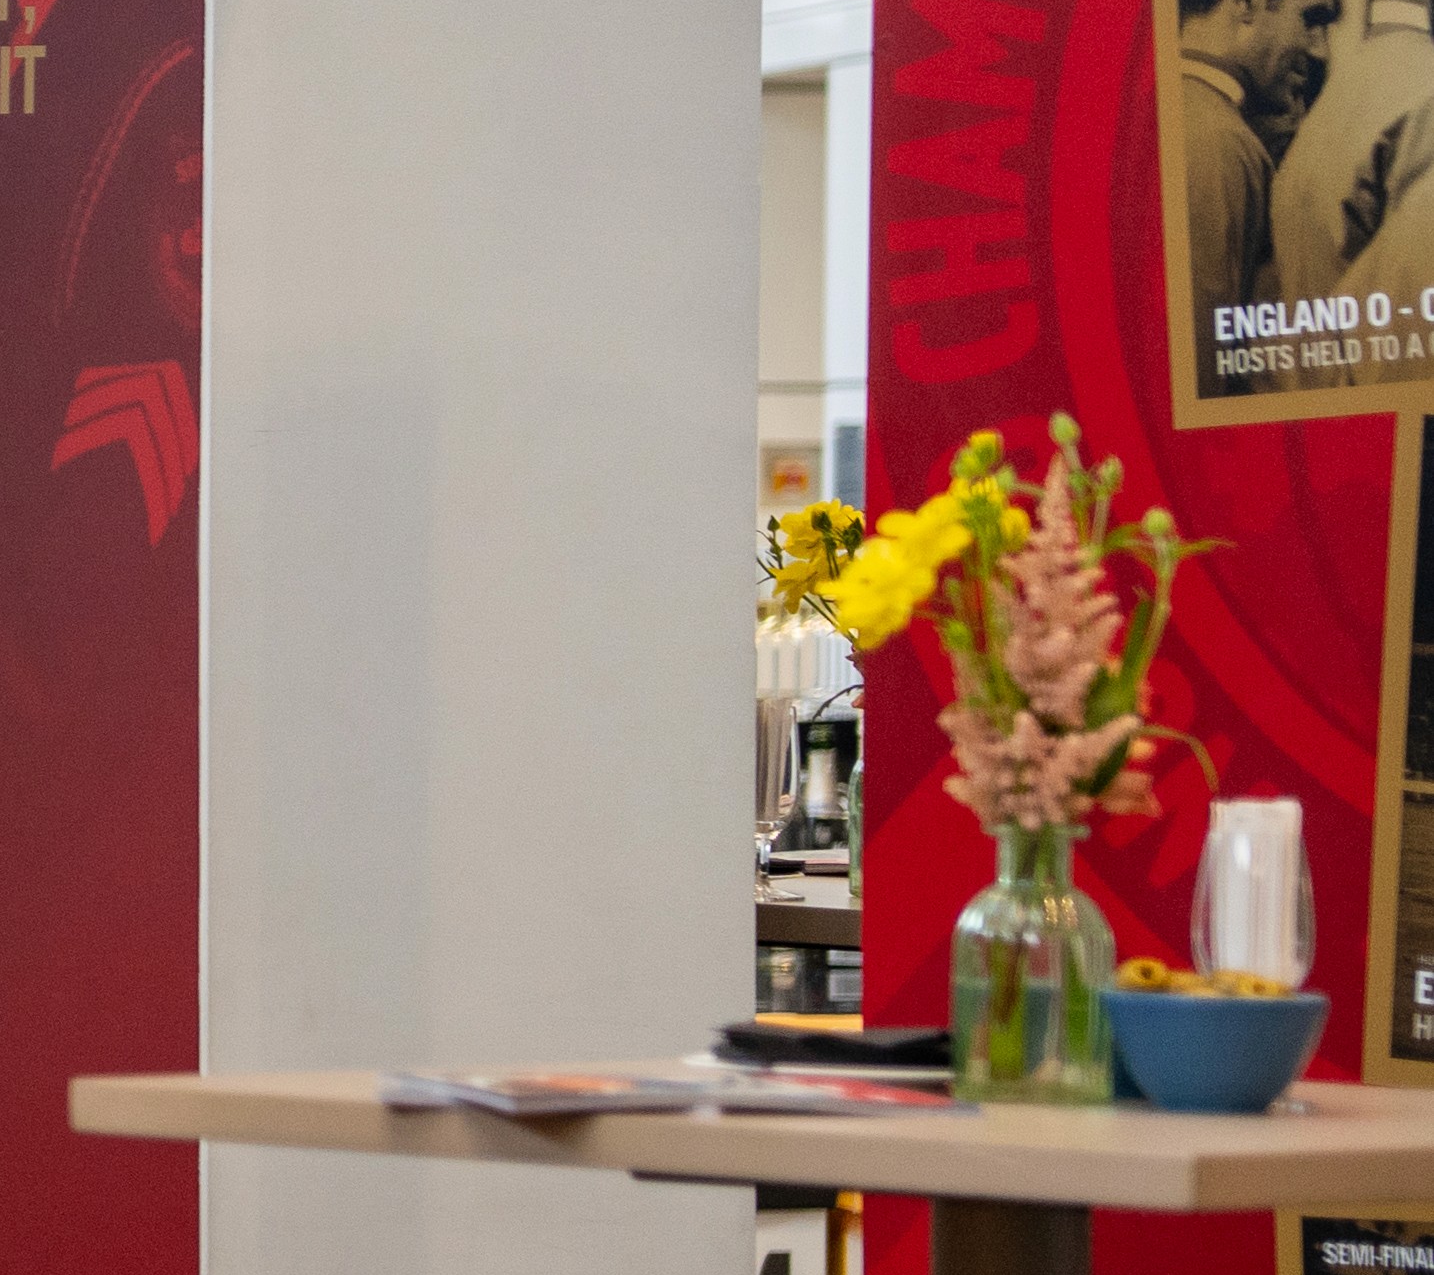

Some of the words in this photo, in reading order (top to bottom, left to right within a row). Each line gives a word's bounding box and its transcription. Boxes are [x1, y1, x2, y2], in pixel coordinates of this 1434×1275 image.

[1214, 296, 1359, 341] ENGLAND
[1217, 345, 1294, 375] HOSTS
[1301, 339, 1361, 367] HELD
[1367, 335, 1400, 361] TO
[1405, 334, 1425, 359] A
